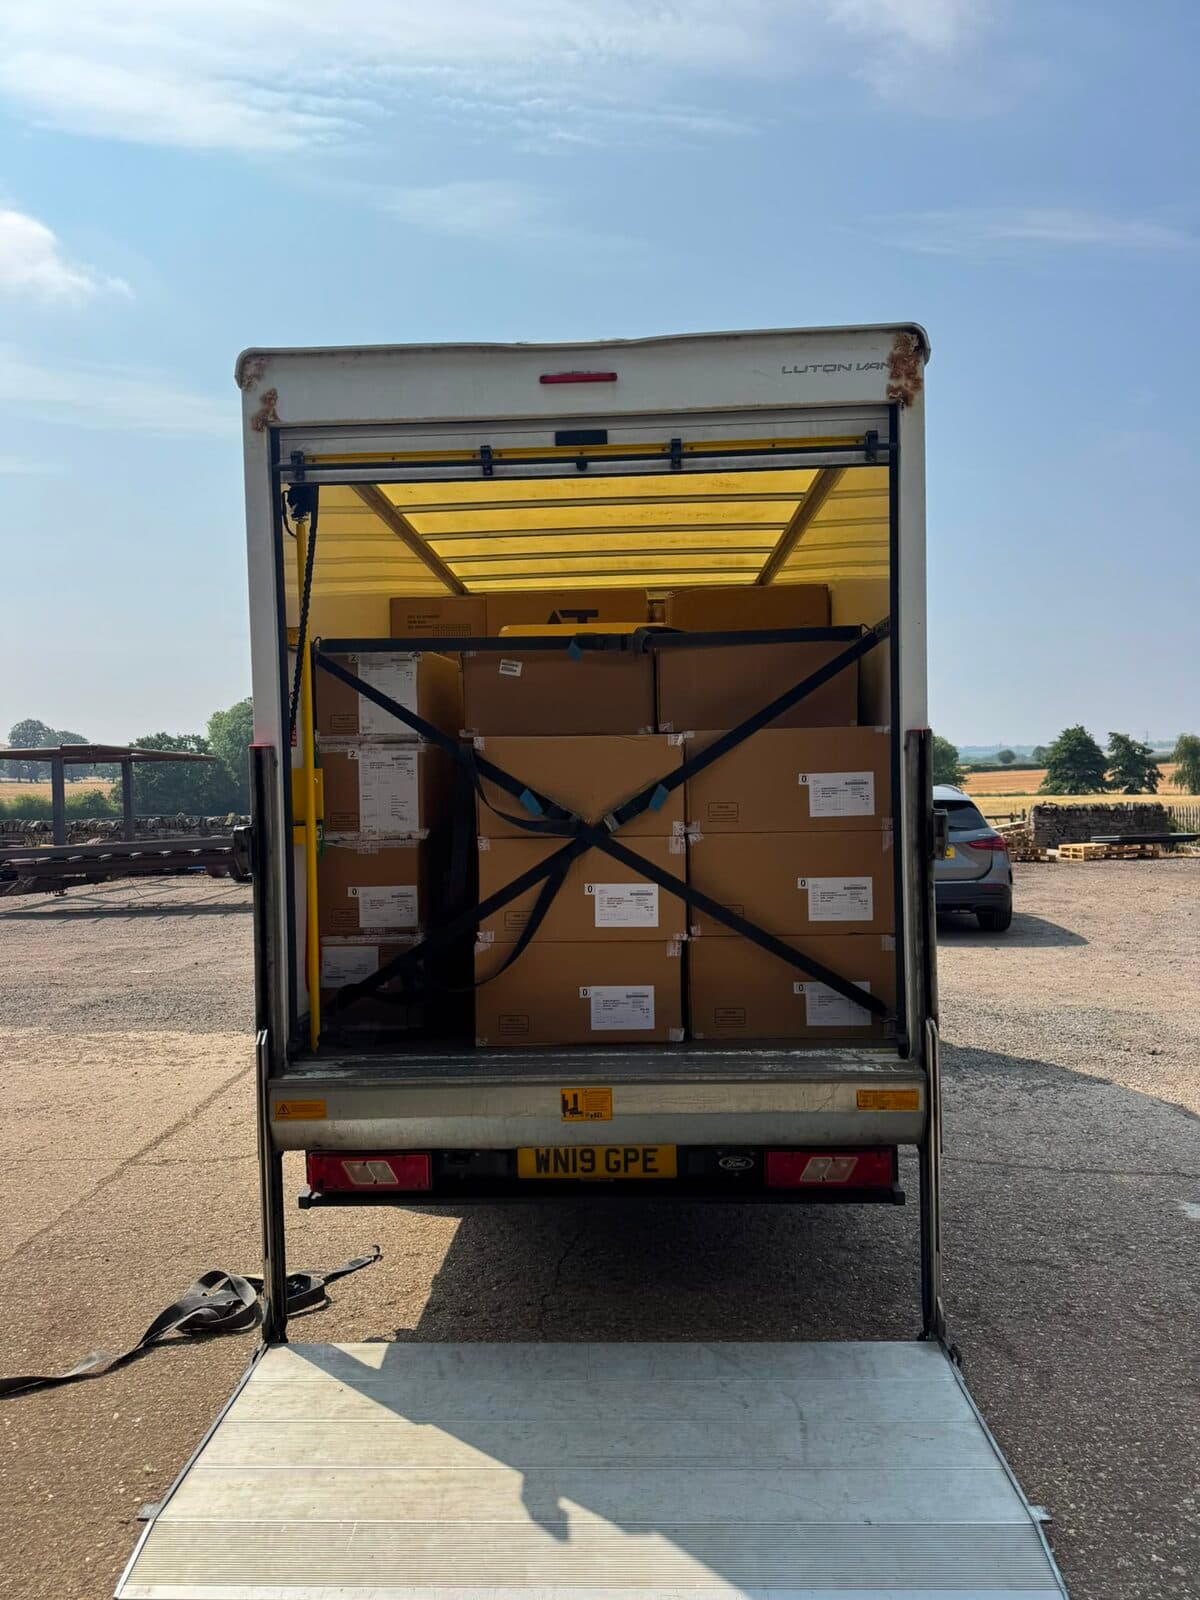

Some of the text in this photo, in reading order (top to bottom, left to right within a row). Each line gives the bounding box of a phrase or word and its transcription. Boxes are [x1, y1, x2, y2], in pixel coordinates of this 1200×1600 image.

[781, 363, 852, 375] LUTON
[535, 1148, 658, 1174] WN19 GPE
